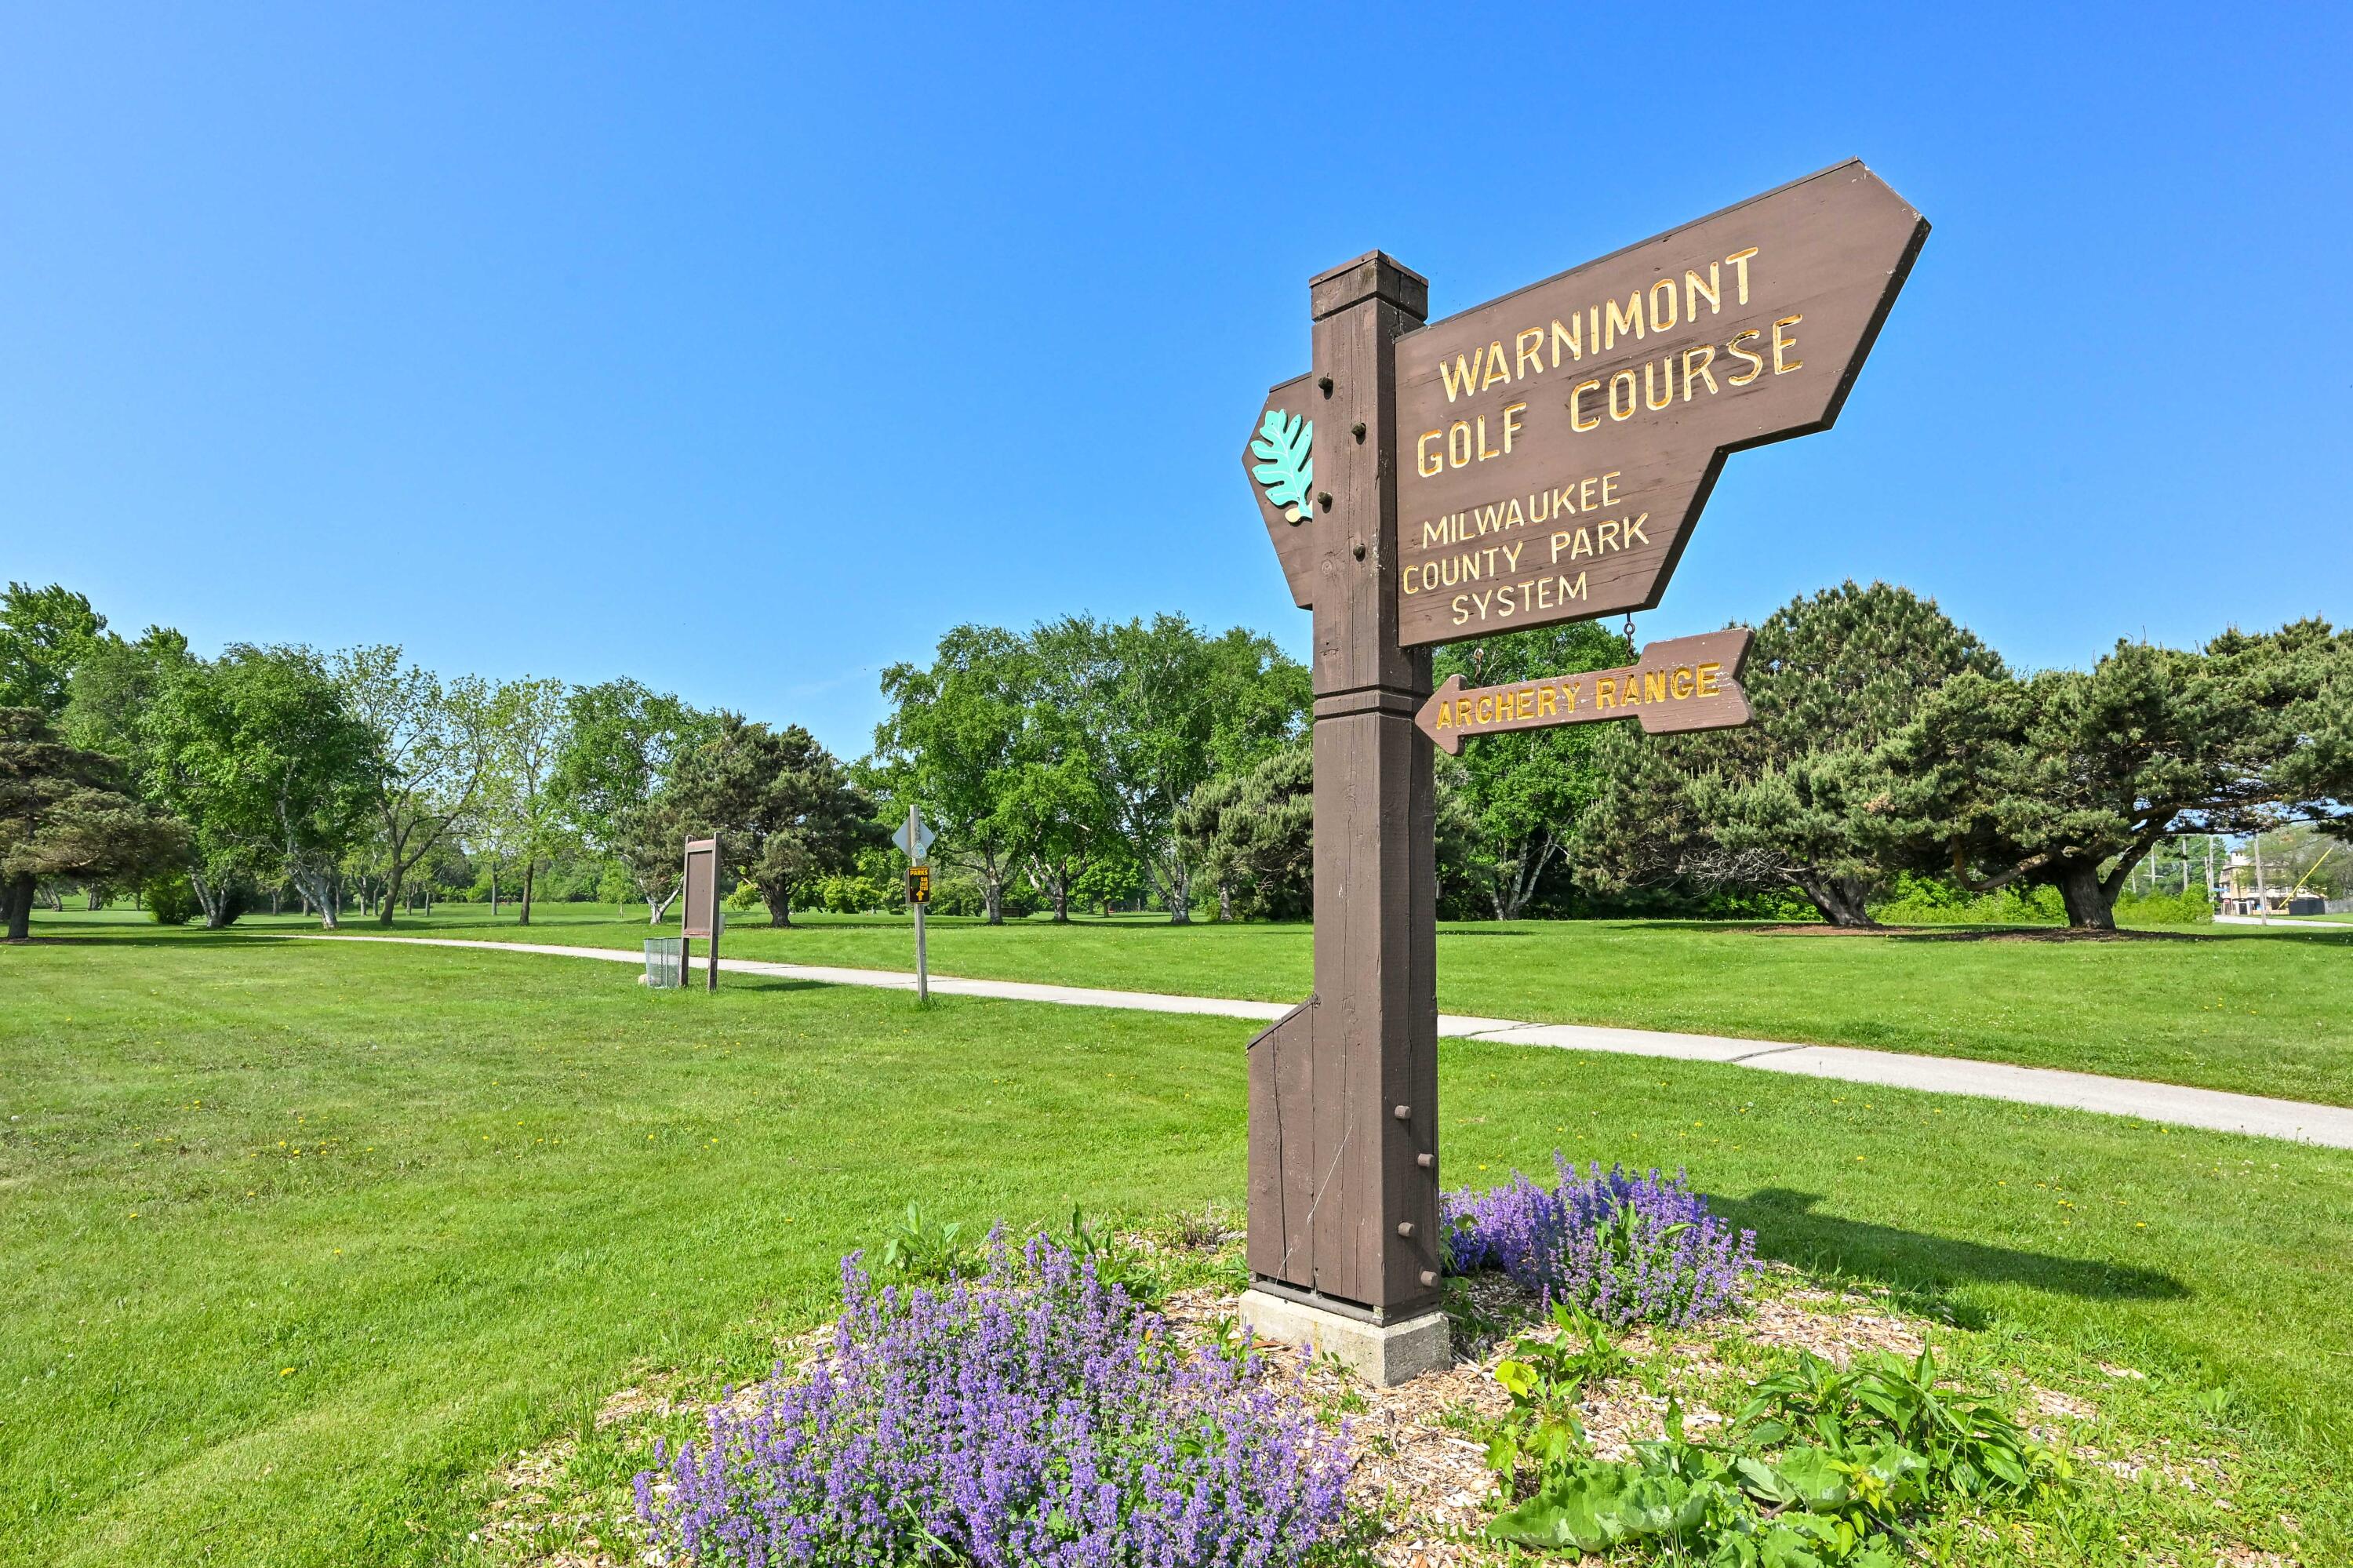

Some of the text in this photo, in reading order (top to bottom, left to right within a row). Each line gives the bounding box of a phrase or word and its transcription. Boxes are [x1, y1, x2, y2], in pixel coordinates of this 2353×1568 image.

[1440, 246, 1758, 402] WARNIMONT
[1417, 314, 1803, 477] GOLF COURSE
[1422, 471, 1621, 549] MILWAUKEE
[1402, 512, 1649, 595] COUNTY PARK
[1452, 572, 1588, 625] SYSTEM
[1436, 662, 1721, 730] ARCHERY RANGE
